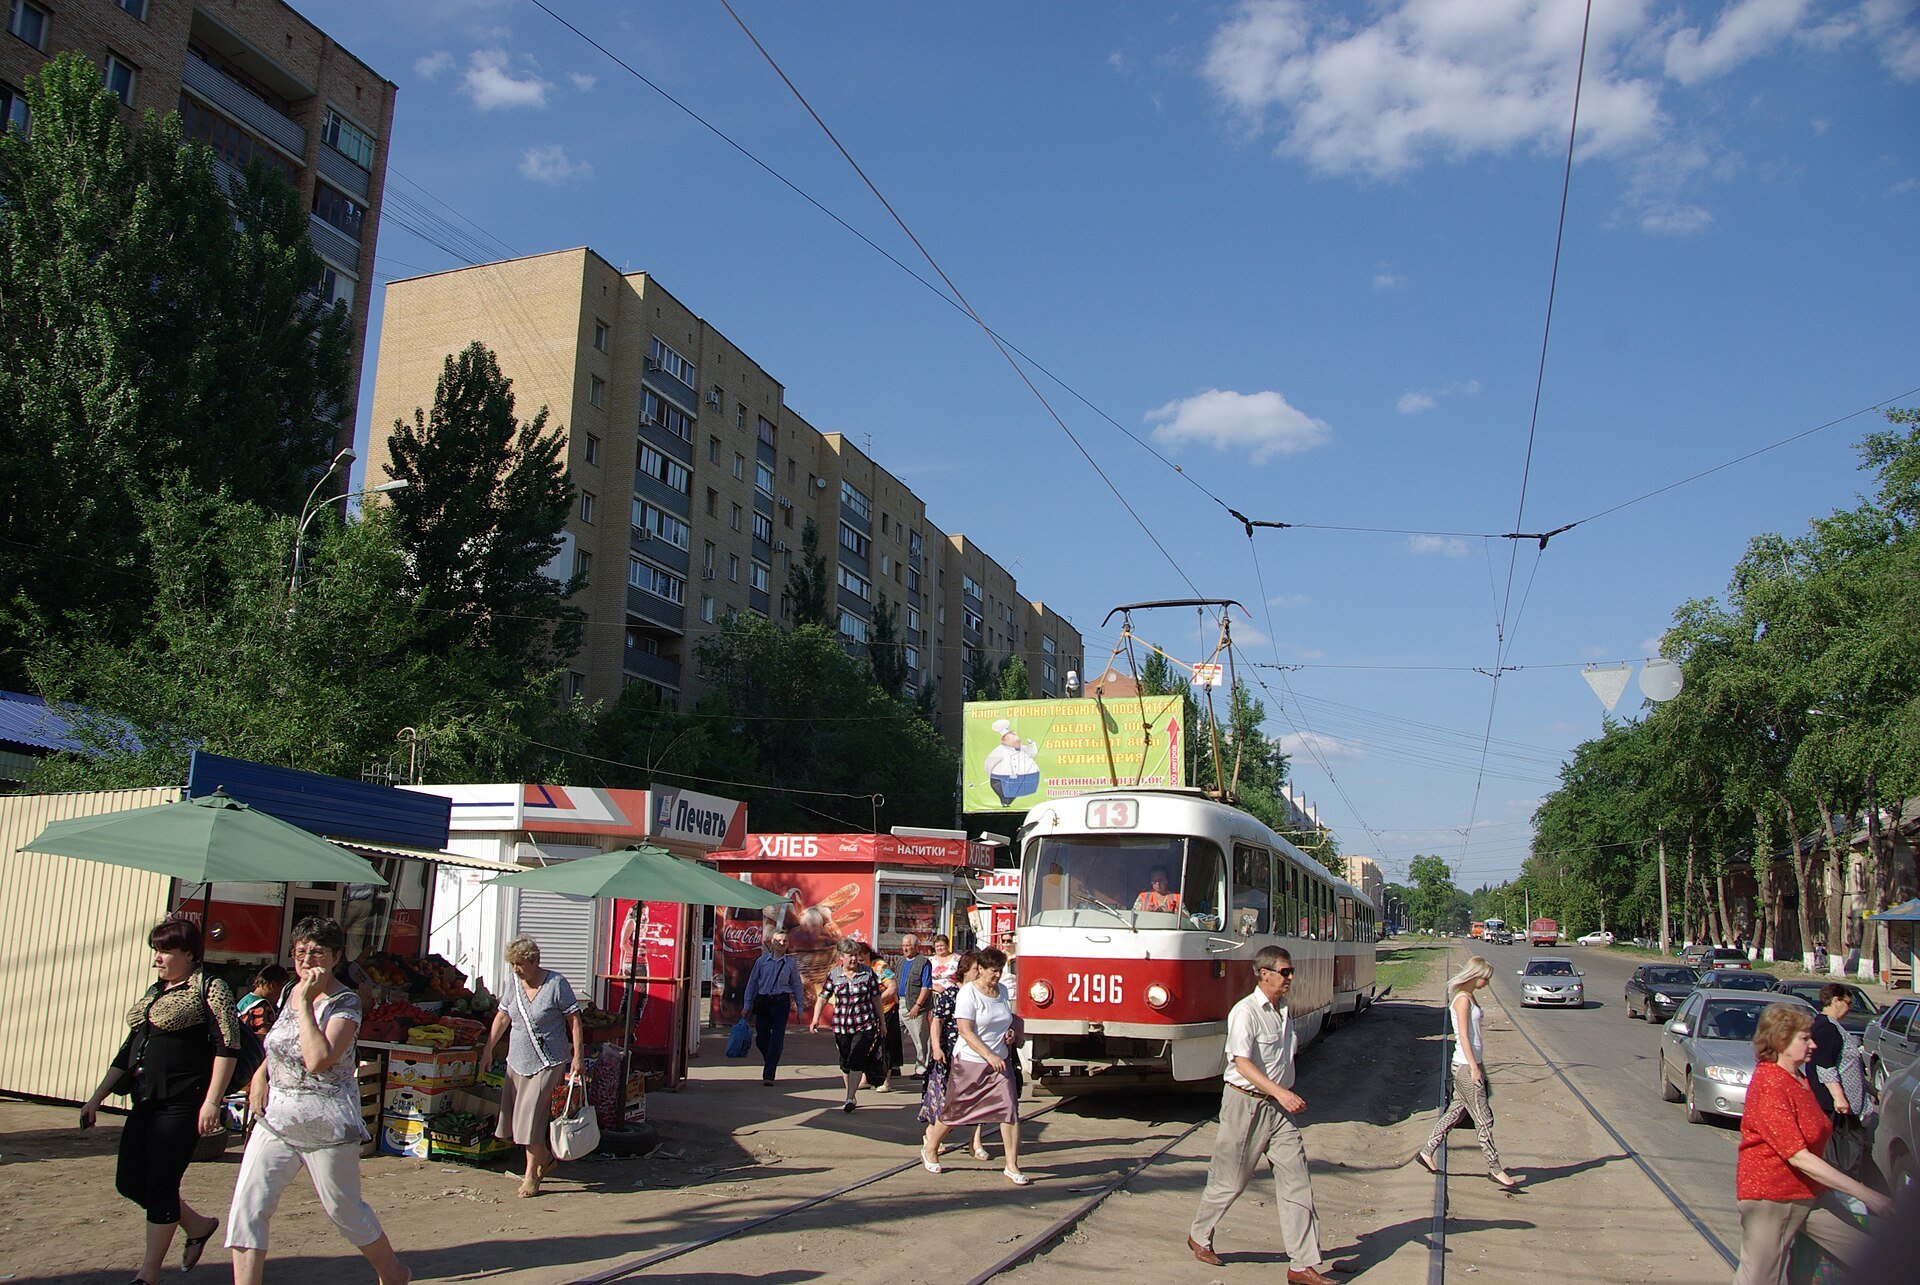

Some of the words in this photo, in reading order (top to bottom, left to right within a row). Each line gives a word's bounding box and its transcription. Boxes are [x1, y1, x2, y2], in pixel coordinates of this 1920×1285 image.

[1006, 705, 1047, 718] СРОЧНО
[1052, 723, 1096, 733] ОБЕДЫ
[675, 799, 727, 838] Печать
[1093, 802, 1129, 828] 13
[758, 836, 818, 857] ХЛЕБ
[897, 844, 946, 857] НАПИТКИ
[968, 847, 991, 867] ХЛЕБ
[724, 924, 761, 945] Coca-Cola
[1067, 973, 1123, 1004] 2196
